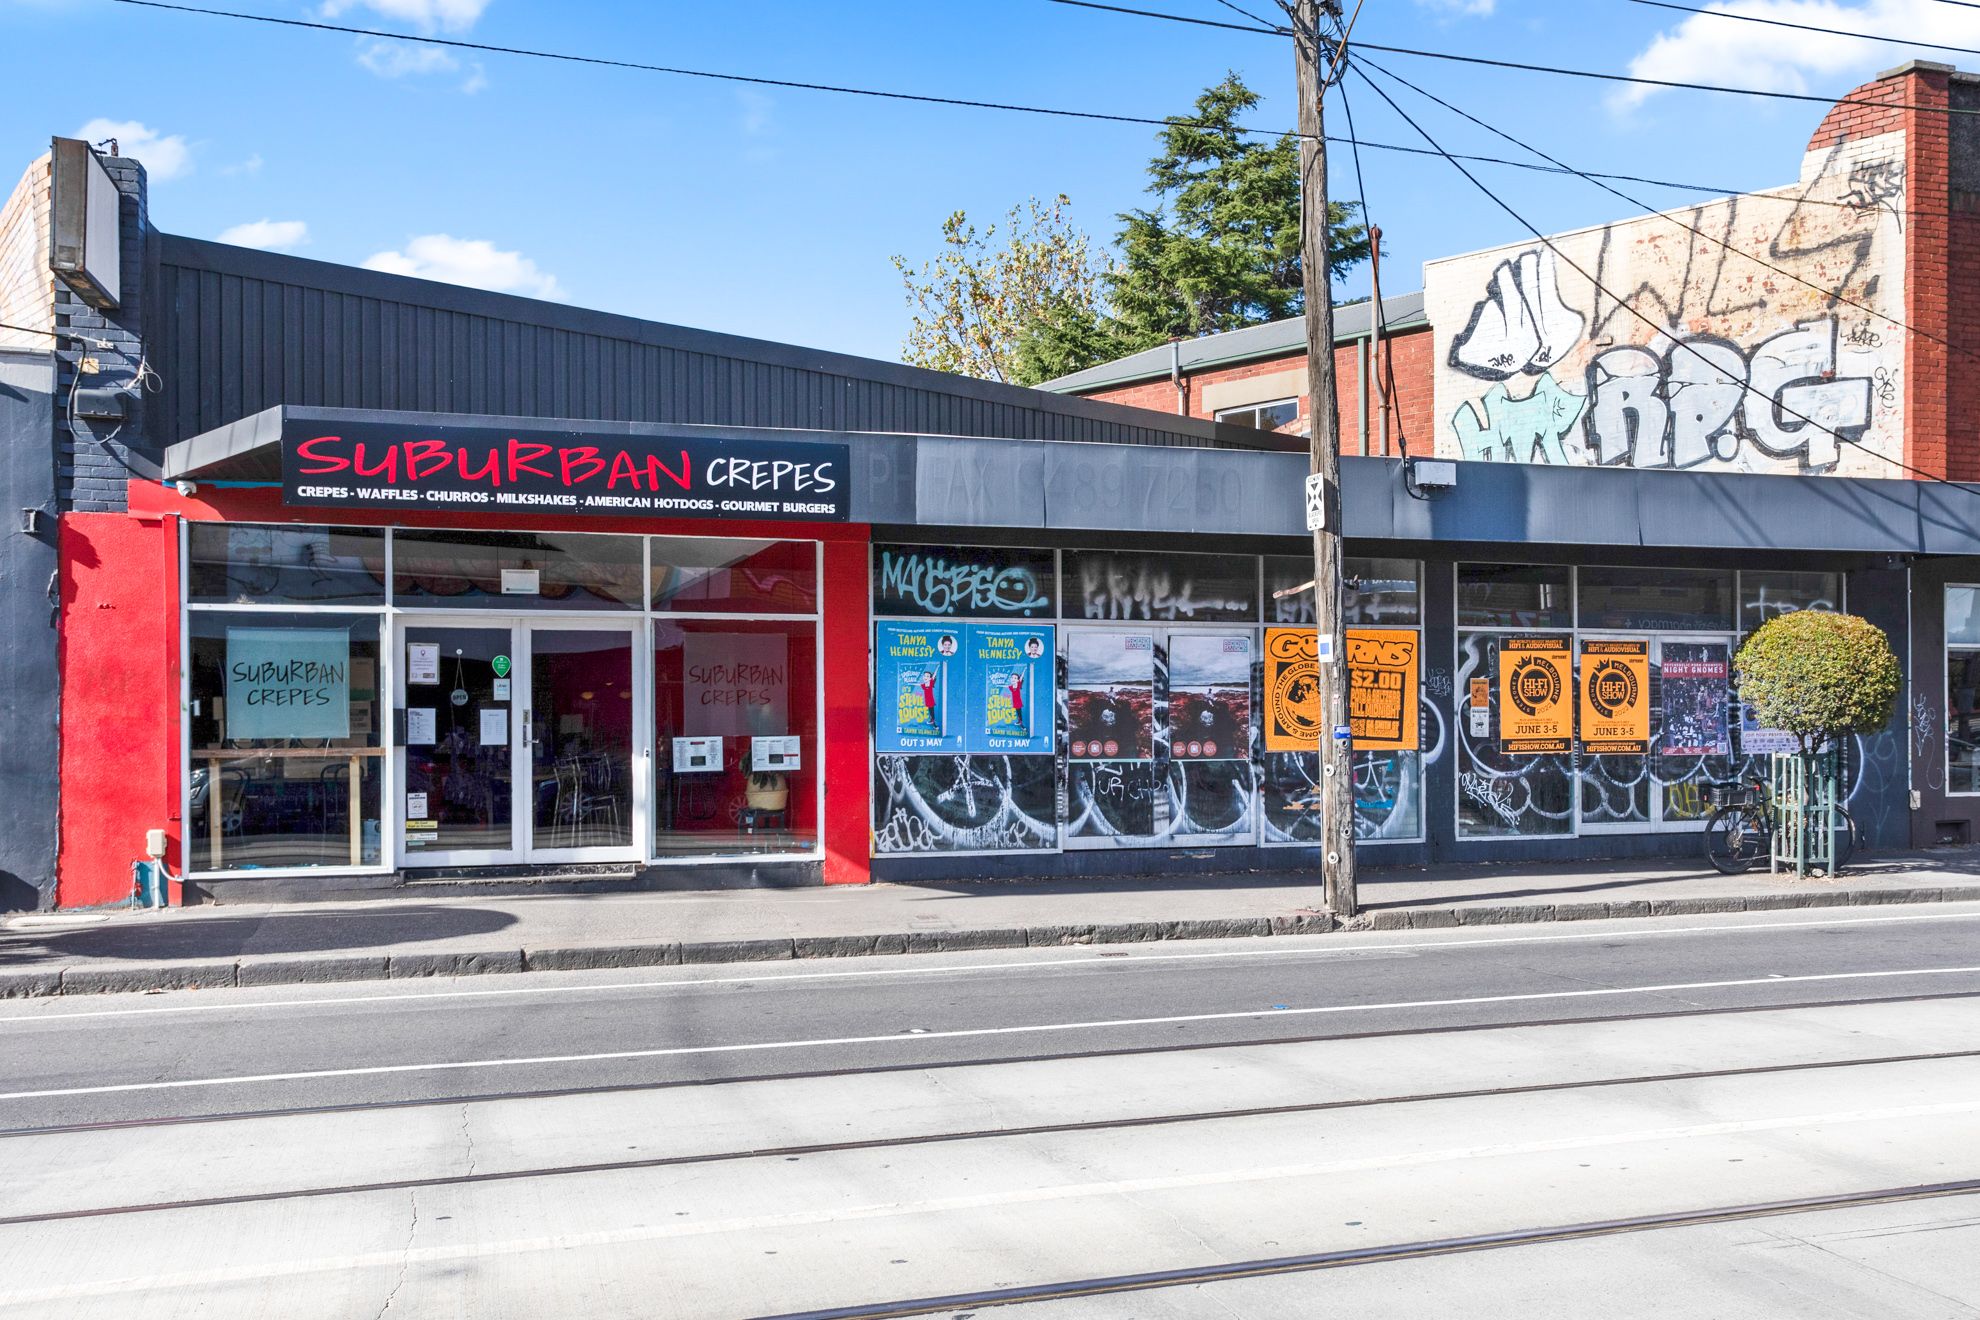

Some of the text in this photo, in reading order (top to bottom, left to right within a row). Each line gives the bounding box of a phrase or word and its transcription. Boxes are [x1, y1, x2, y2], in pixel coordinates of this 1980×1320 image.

[297, 436, 836, 493] SUBURBAN CREPES
[297, 486, 836, 514] CREPES WAFFLES CHURROS MILKSHAKES AMERICAN HOTDOGS GOURMET BURGERS
[898, 633, 927, 646] TANYA
[986, 636, 1015, 649] TANYA
[890, 645, 935, 658] HENNESSY
[978, 648, 1022, 660] HENNESSY
[233, 659, 344, 685] SUBURBAN
[689, 663, 783, 686] SUBURBAN
[1287, 662, 1316, 675] GLOBE
[1663, 666, 1690, 674] NIGHT
[1277, 672, 1289, 690] THE
[1351, 669, 1401, 689] $2.00
[1524, 678, 1548, 688] HI-FI
[1536, 659, 1560, 701] MELBOURNE
[1614, 662, 1637, 703] MELBOURNE
[1524, 688, 1548, 697] SHOW
[1601, 682, 1625, 692] HI-FI
[247, 688, 330, 706] CREPES
[701, 688, 771, 706] CREPES
[899, 693, 925, 708] STEVIE
[987, 695, 1012, 709] STEVIE
[1601, 691, 1625, 700] SHOW
[899, 706, 929, 724] LOUISE
[1275, 696, 1293, 730] AROUND
[1536, 703, 1553, 714] 2022
[1614, 706, 1629, 717] 2022
[987, 707, 1017, 725] LOUISE
[1515, 725, 1558, 734] JUNE 3-5
[1593, 727, 1634, 736] JUNE 3-5
[900, 737, 943, 747] OUT 3 MAY
[989, 739, 1031, 748] OUT 3 MAY
[1508, 742, 1565, 751] HIFISHOW.COM.AU
[1586, 744, 1641, 752] HIFISHOW.COM.AU
